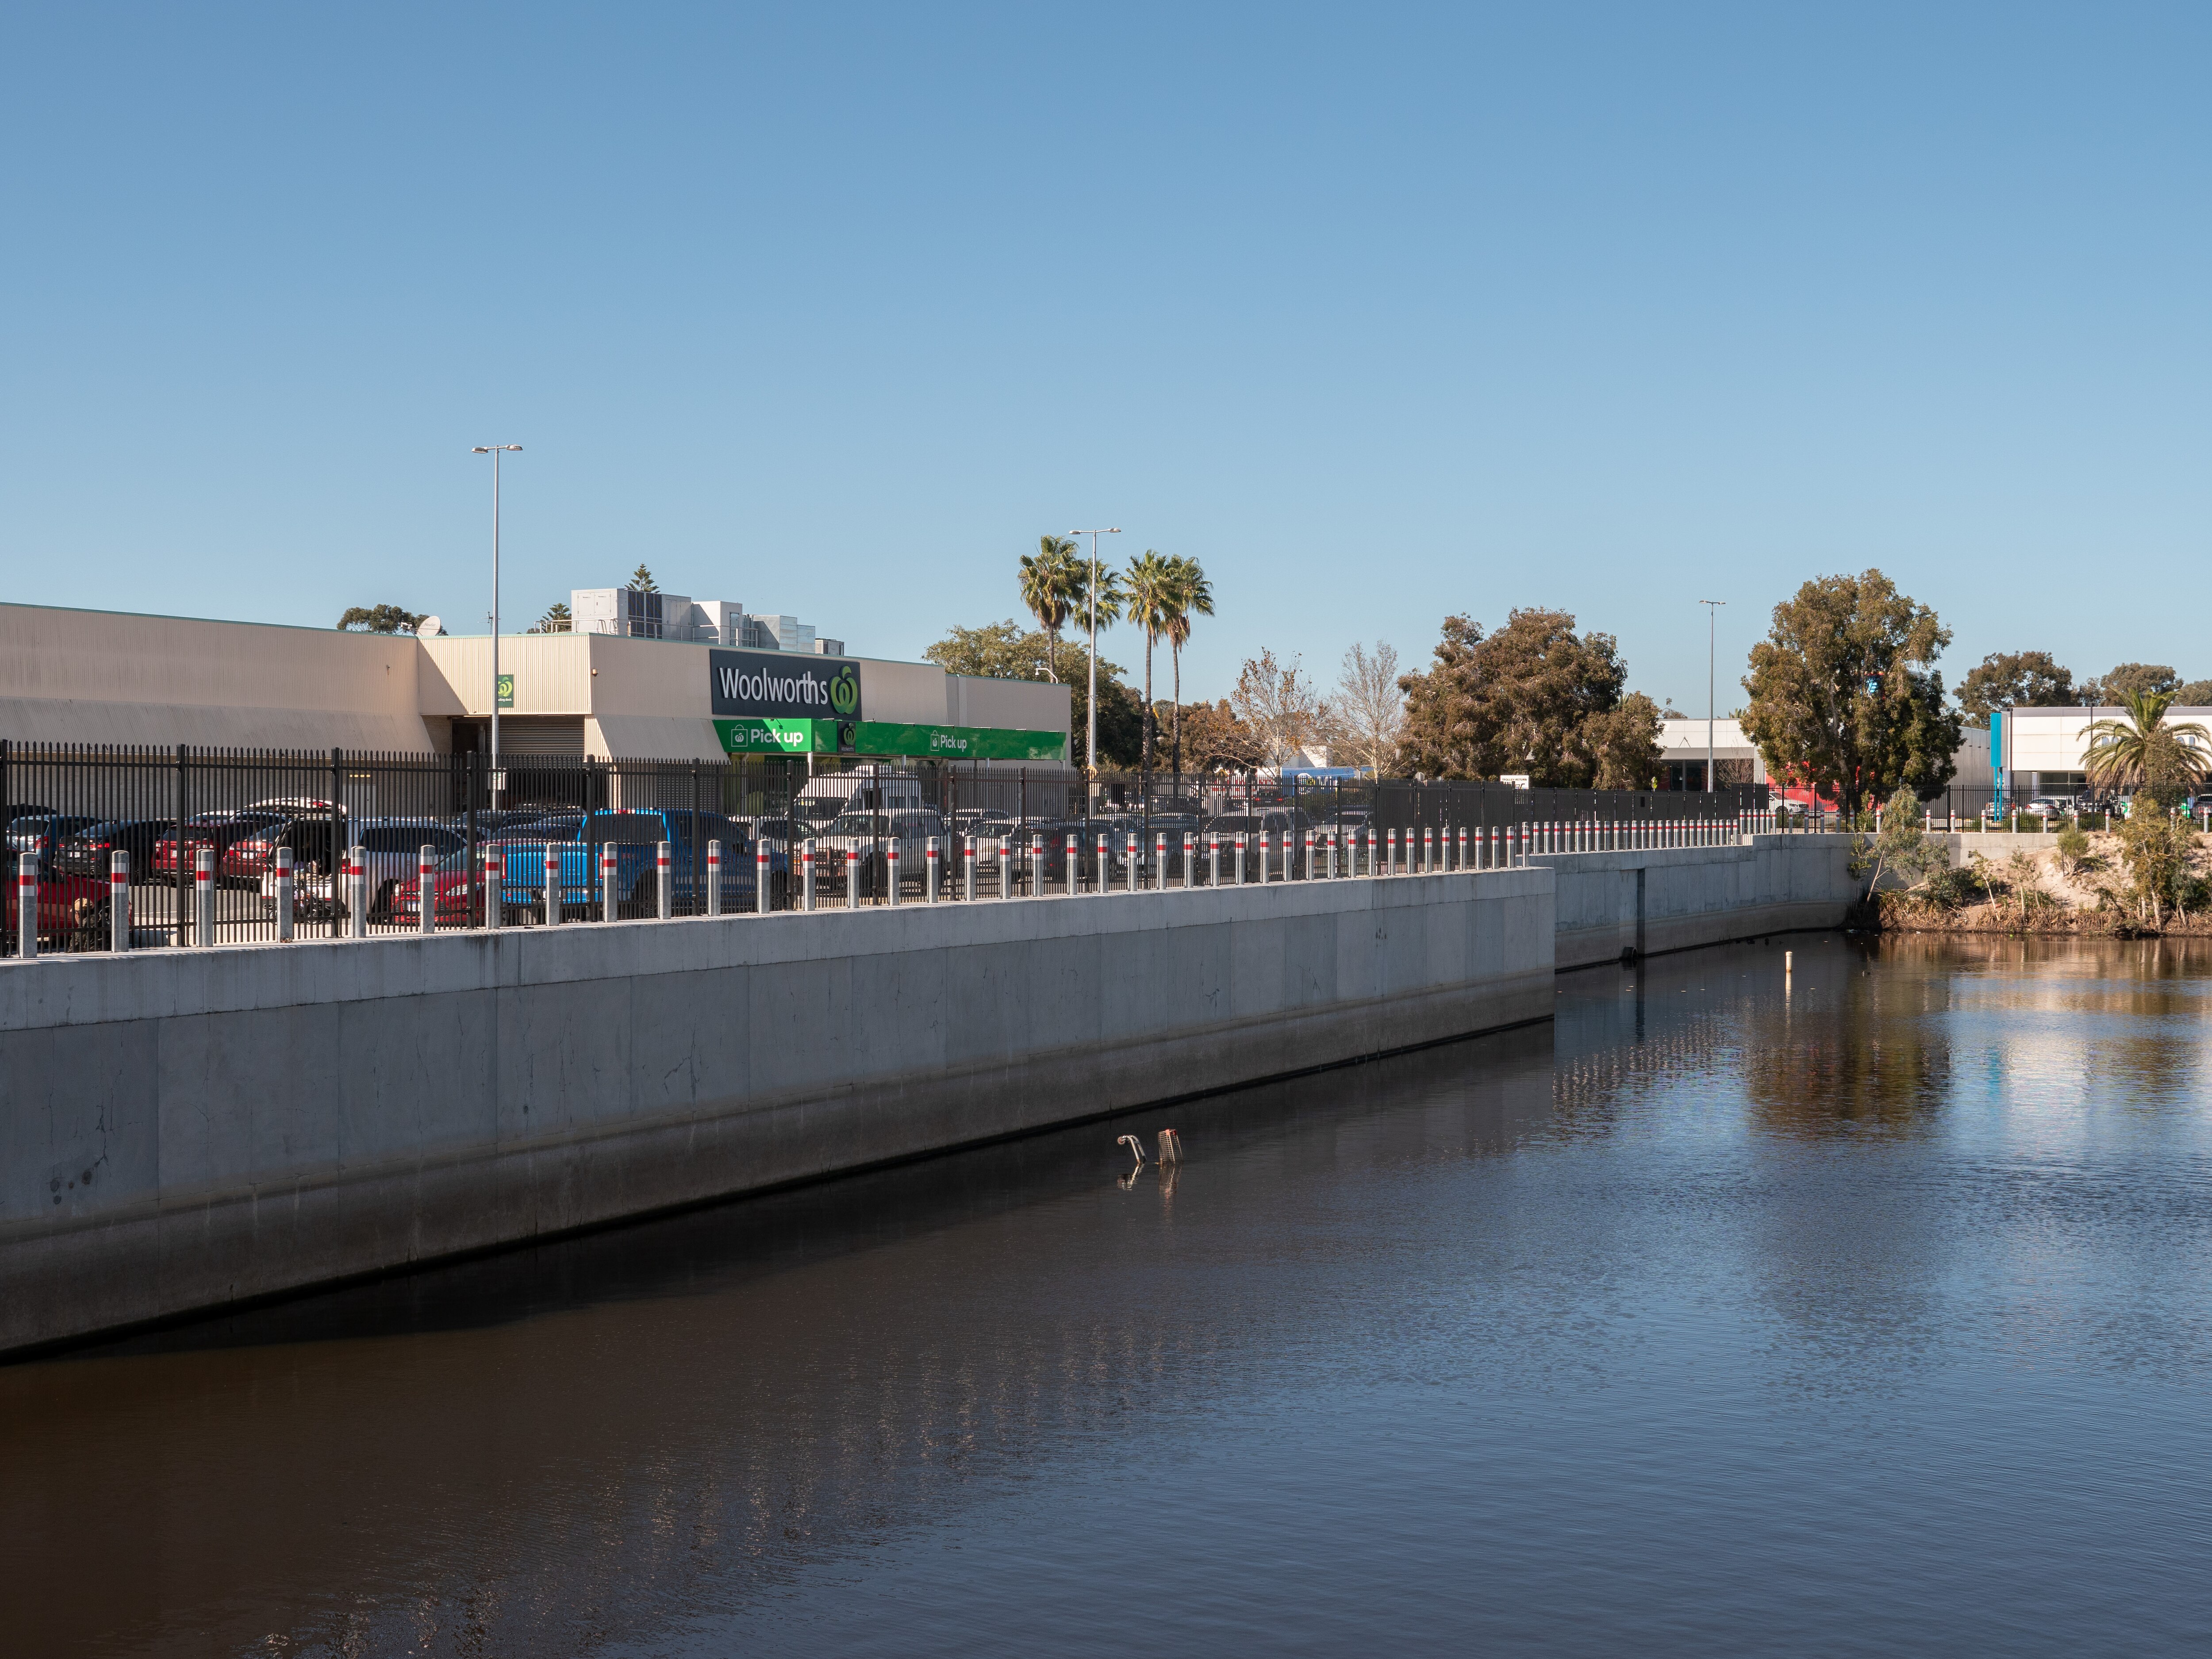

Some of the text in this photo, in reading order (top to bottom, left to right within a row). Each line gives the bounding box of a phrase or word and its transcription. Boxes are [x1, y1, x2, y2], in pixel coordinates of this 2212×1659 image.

[719, 667, 828, 705] Woolworths
[751, 729, 803, 747] Pick up
[941, 734, 967, 753] Pick up
